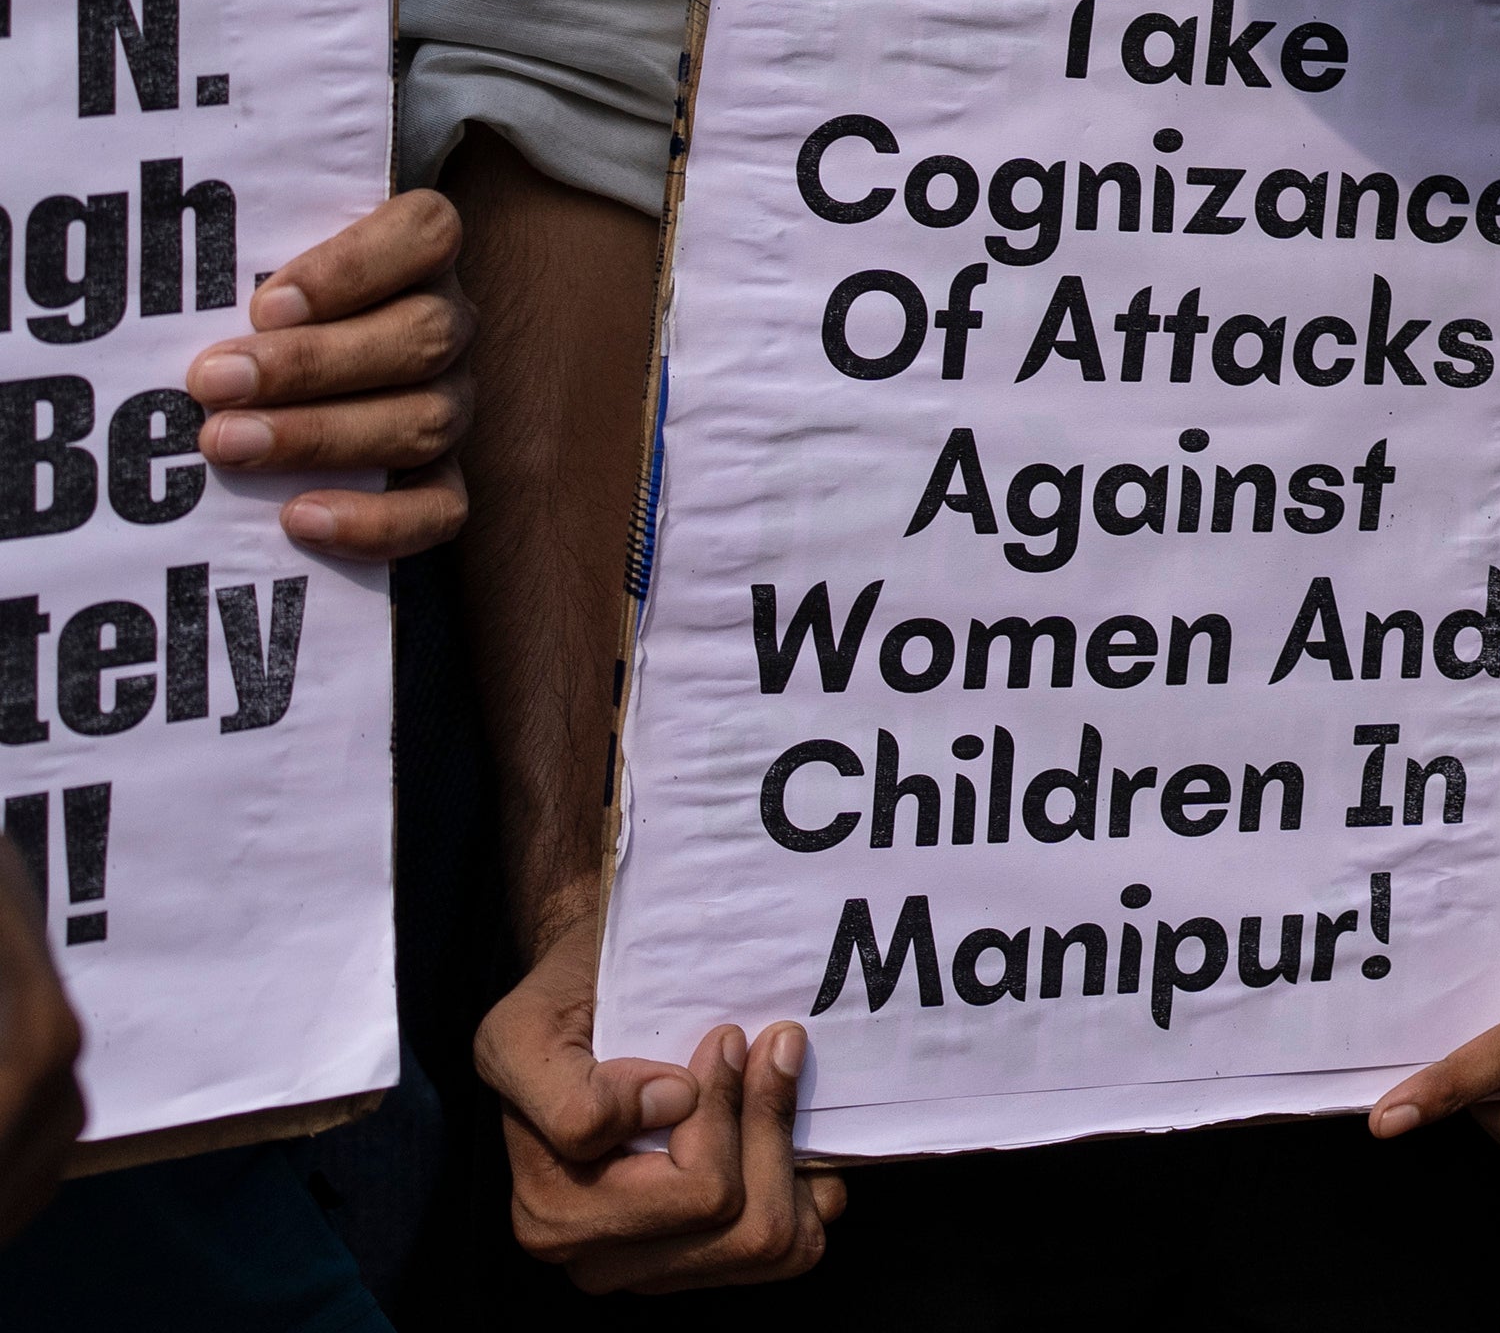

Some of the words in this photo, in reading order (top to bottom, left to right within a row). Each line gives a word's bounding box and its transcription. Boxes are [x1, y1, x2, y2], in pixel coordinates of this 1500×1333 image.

[821, 263, 988, 381] Of
[1015, 273, 1496, 389] Attacks
[904, 427, 1396, 573] Against
[750, 579, 1232, 695] Women
[759, 723, 1305, 853] Children
[1345, 723, 1467, 830] In
[808, 873, 1393, 1030] Manipur!
